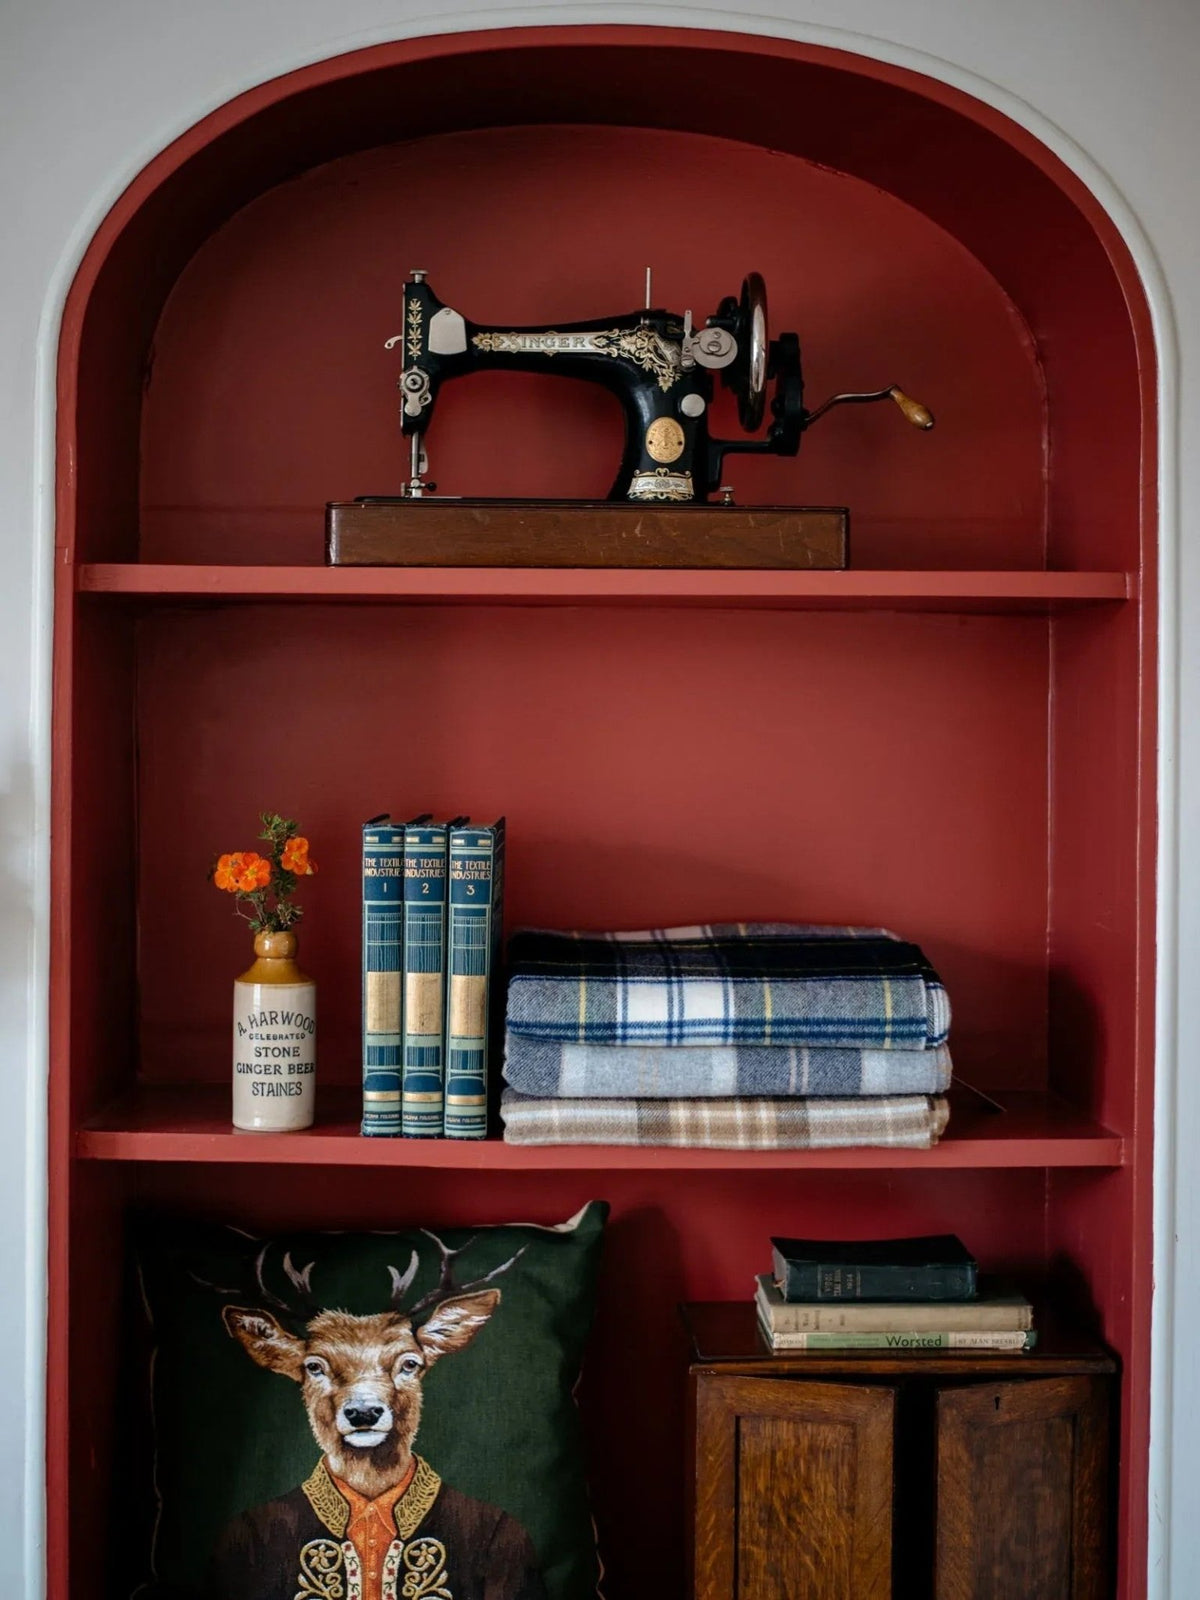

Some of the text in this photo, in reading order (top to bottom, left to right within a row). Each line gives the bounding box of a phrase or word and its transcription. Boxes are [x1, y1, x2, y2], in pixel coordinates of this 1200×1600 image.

[405, 858, 445, 868] THE TEXTILE
[465, 860, 491, 870] TEXTILE
[405, 868, 445, 878] INDUSTRIES
[383, 882, 387, 893] 1
[422, 882, 430, 894] 2
[466, 884, 475, 895] 3
[247, 1010, 315, 1035] HARWOOD
[248, 1033, 306, 1041] CELEBRATED
[254, 1046, 301, 1058] STONE
[236, 1062, 316, 1075] GINGER BEER
[251, 1081, 303, 1097] STAINES
[884, 1334, 942, 1347] Worsted
